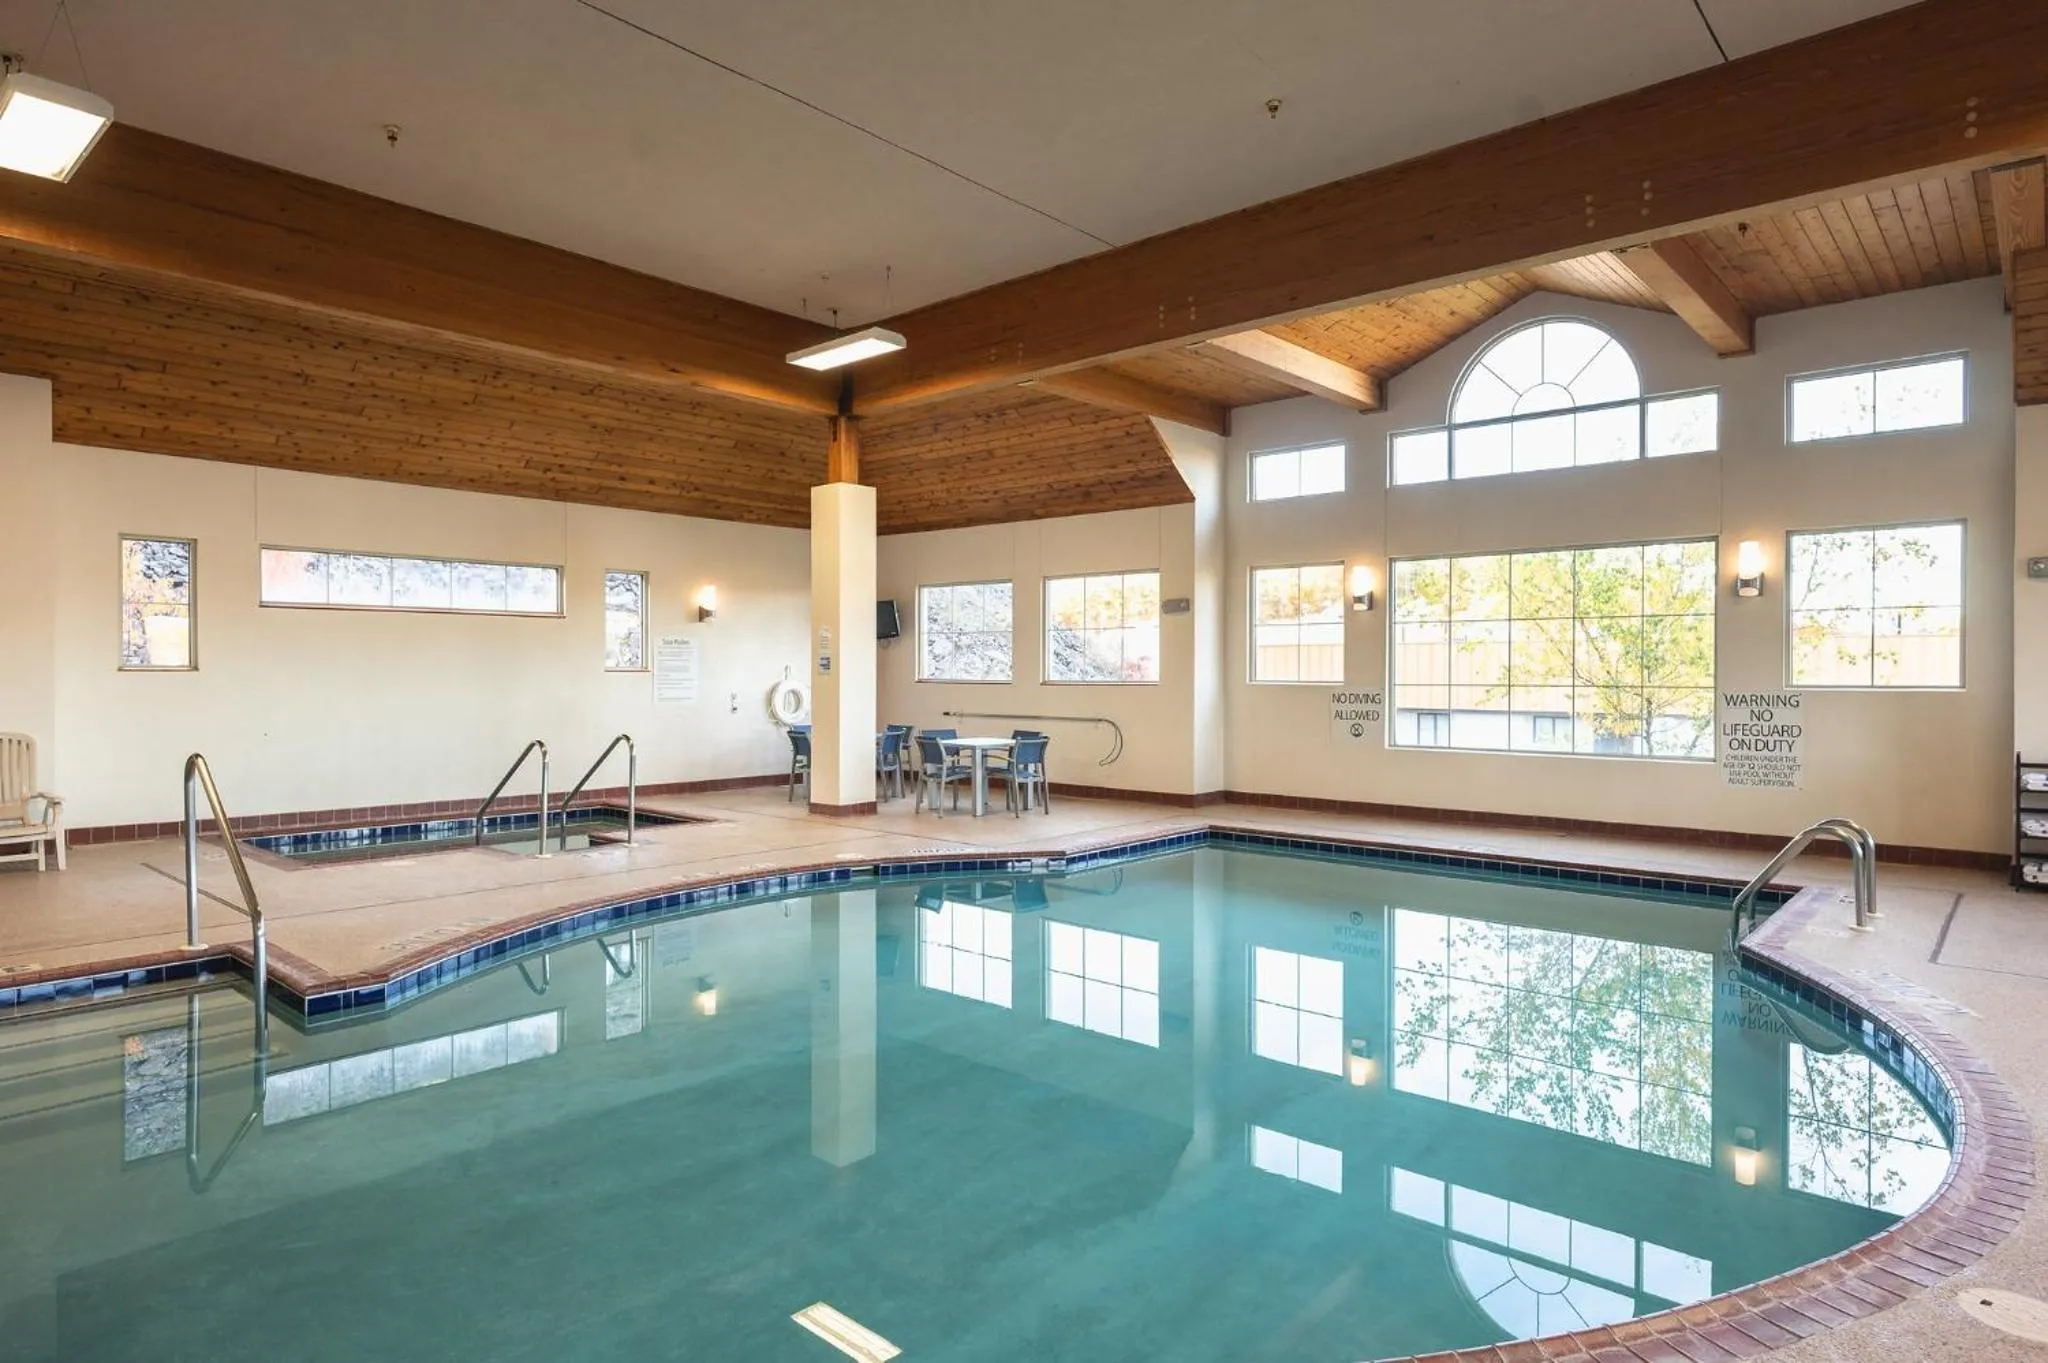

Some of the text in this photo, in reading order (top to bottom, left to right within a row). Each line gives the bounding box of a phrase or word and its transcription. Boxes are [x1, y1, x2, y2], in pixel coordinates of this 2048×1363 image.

[1332, 693, 1381, 704] NO DIVING
[1723, 693, 1800, 708] WARNING
[1333, 709, 1380, 721] ALLOWED
[1749, 709, 1773, 722] NO
[1729, 738, 1796, 752] ON DUTY
[1725, 754, 1760, 762] CHILDREN
[1783, 756, 1798, 764] THE
[1757, 763, 1786, 771] SHOULD
[1762, 770, 1795, 779] WITHOUT
